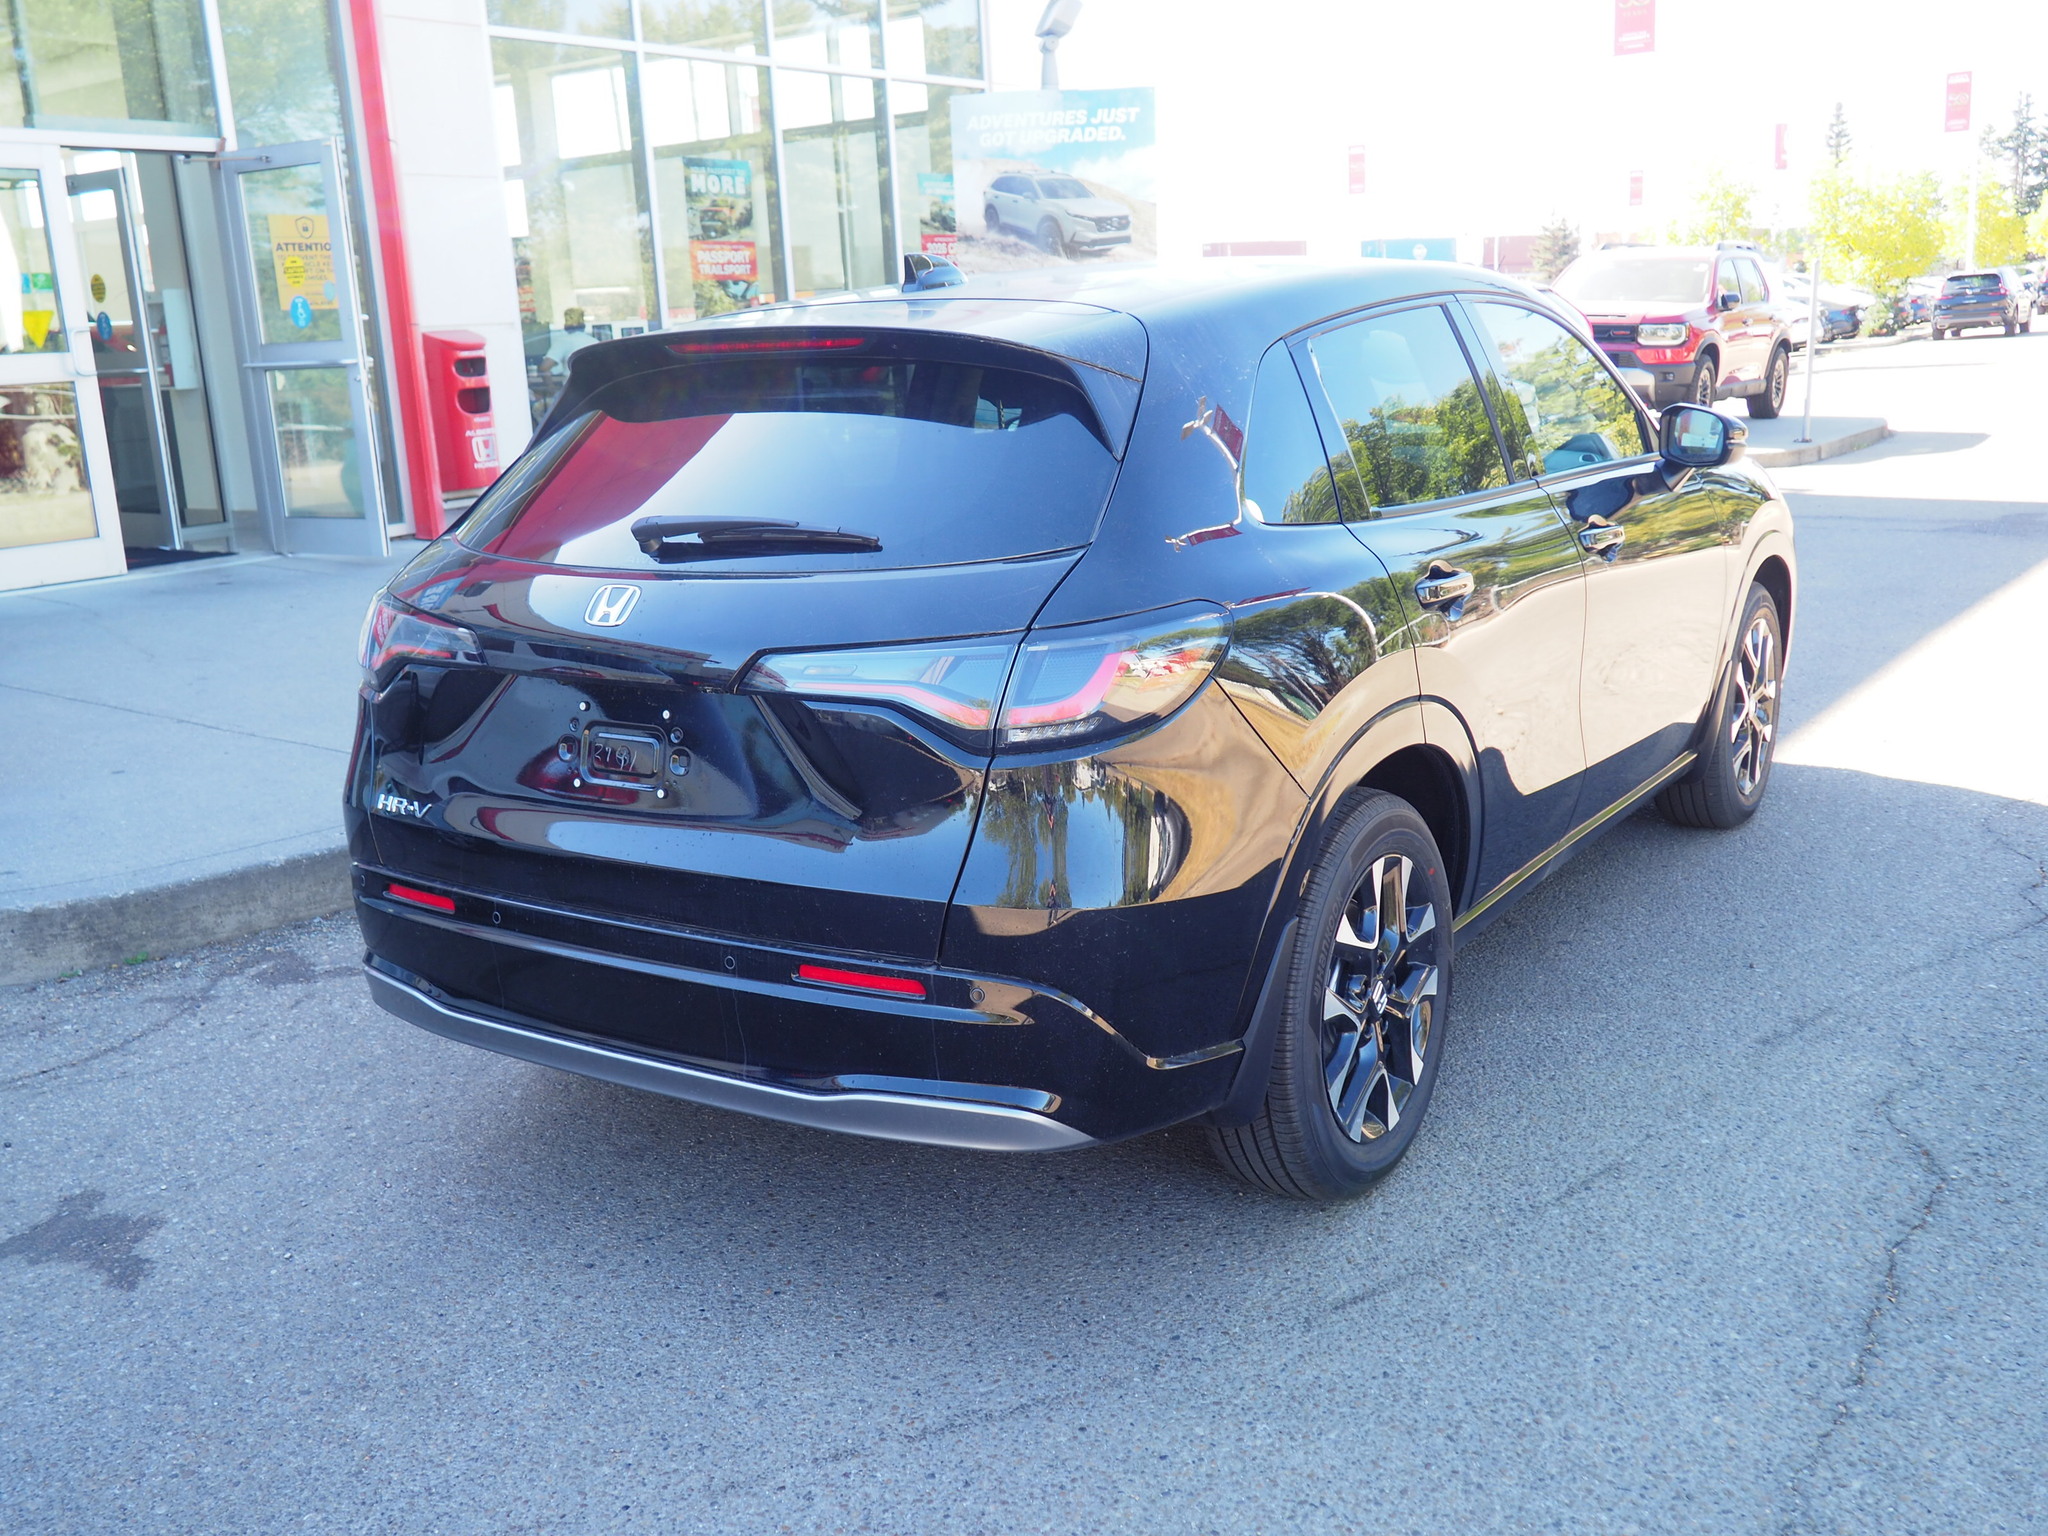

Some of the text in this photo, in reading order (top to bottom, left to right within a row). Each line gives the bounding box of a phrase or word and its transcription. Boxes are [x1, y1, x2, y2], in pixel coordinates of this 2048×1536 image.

[967, 107, 1140, 131] ADVENTURES JUST
[980, 125, 1126, 147] GOT UPGRADED.
[691, 173, 747, 194] MORE
[276, 242, 332, 251] ATTENTIO
[696, 250, 750, 264] PASSPORT
[698, 264, 751, 276] TRAILSPORT
[377, 794, 433, 818] HR-V
